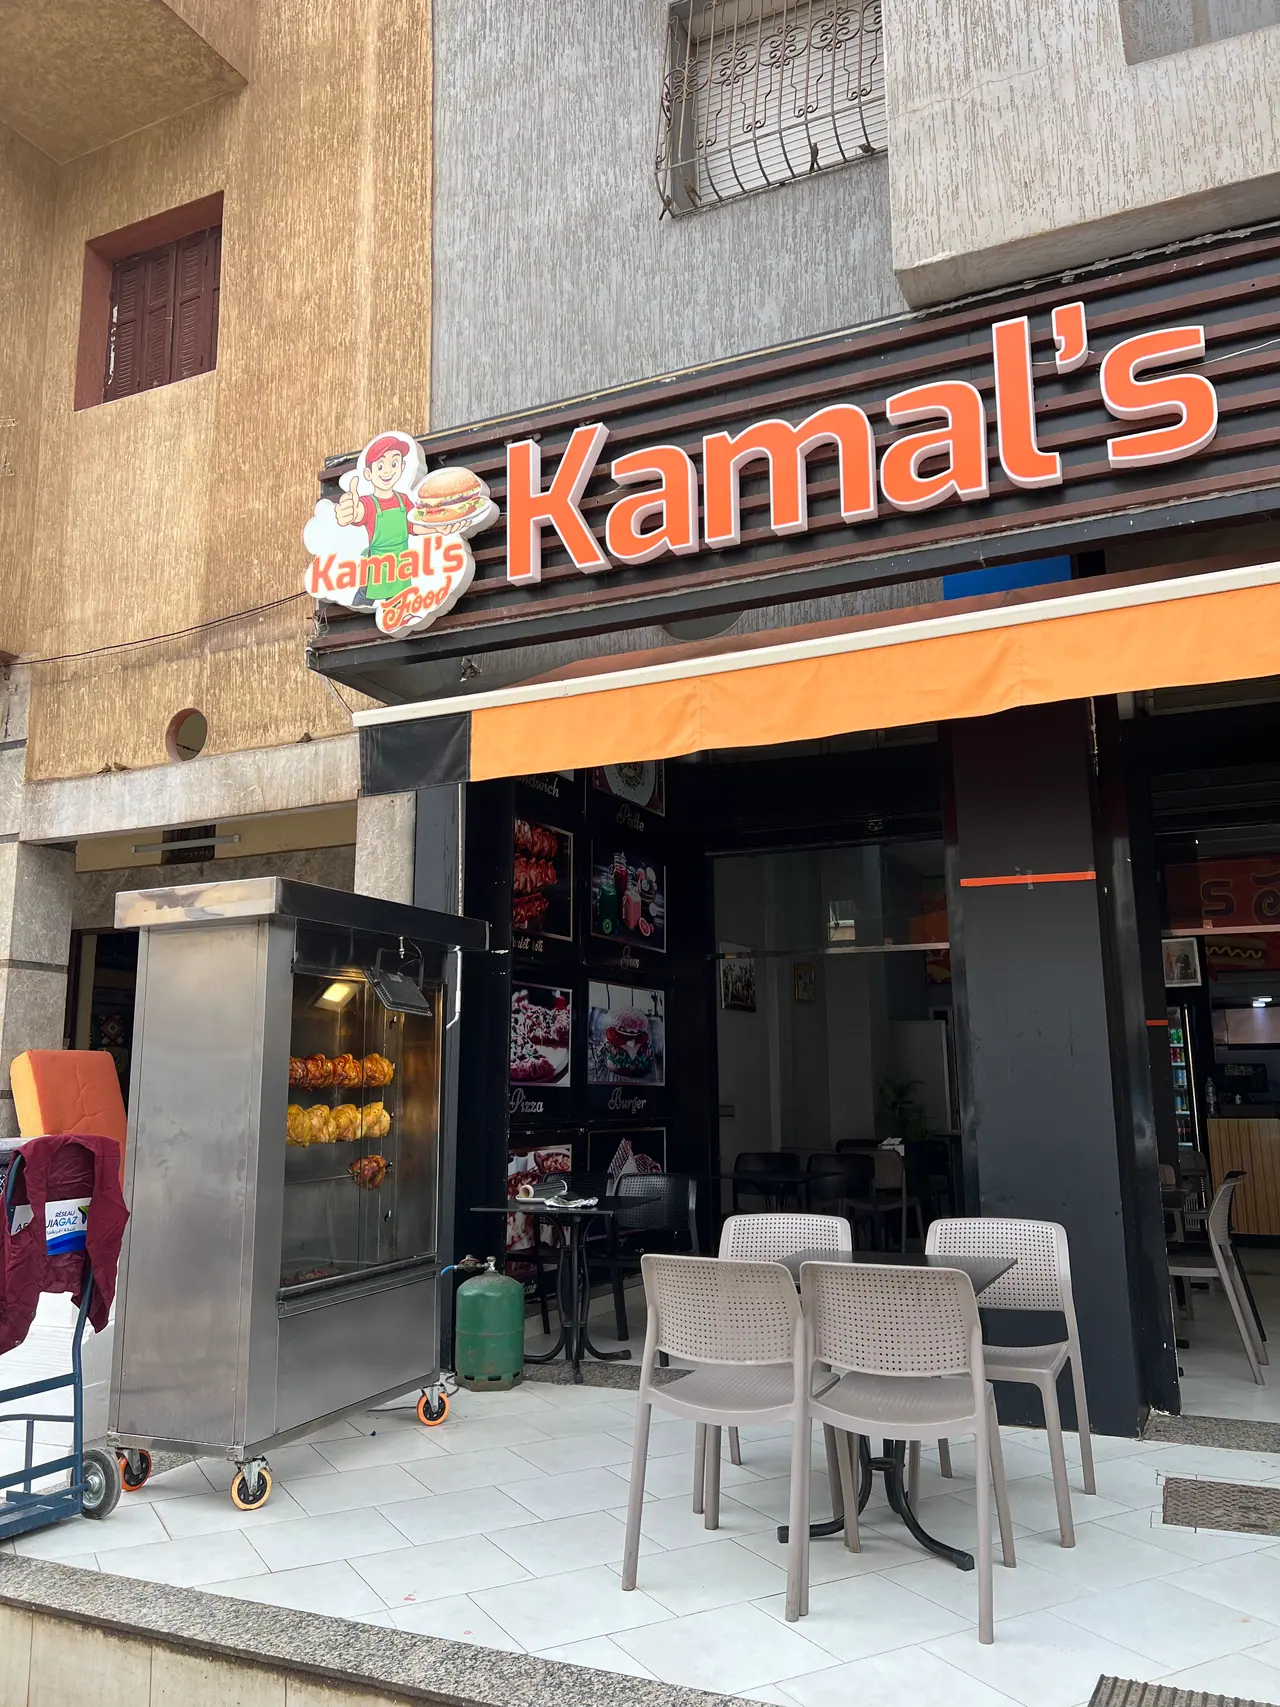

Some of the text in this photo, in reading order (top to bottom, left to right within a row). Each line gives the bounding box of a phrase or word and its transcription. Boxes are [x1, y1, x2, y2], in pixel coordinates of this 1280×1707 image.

[504, 301, 1219, 586] Kamal's
[310, 534, 465, 594] Kamal's
[380, 575, 453, 632] Food
[515, 775, 560, 798] andwich
[620, 945, 640, 970] Jus
[509, 1087, 544, 1113] Pizza
[608, 1087, 647, 1115] Burger
